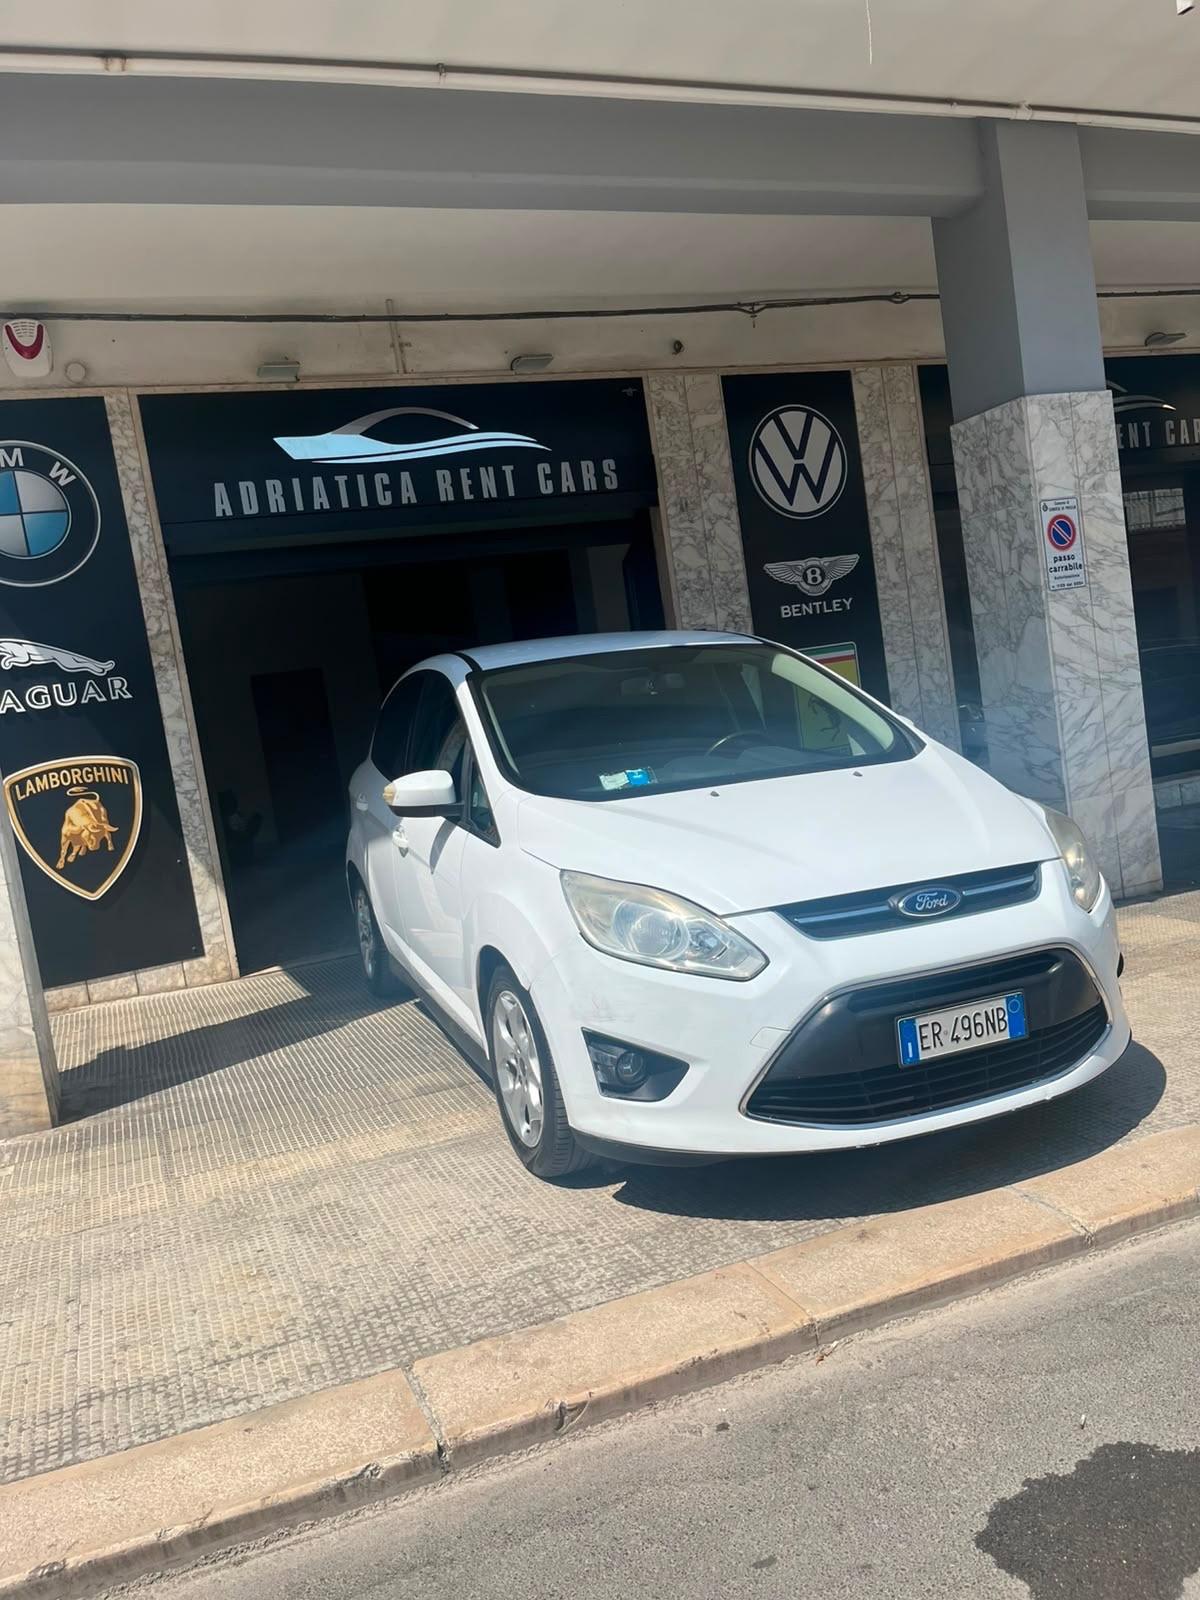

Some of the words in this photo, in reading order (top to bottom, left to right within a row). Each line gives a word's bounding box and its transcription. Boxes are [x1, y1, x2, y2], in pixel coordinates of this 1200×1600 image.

[1116, 422, 1150, 449] ENT
[1165, 417, 1200, 446] CAR
[0, 447, 77, 487] MW
[214, 471, 418, 517] ADRIATICA
[435, 465, 516, 502] RENT
[537, 458, 618, 495] CARS
[1049, 562, 1083, 573] carrabile
[1053, 554, 1075, 563] passo
[780, 597, 853, 618] BENTLEY
[0, 676, 133, 714] AGUAR
[15, 766, 129, 801] LAMBORGHINI
[915, 891, 949, 911] Ford
